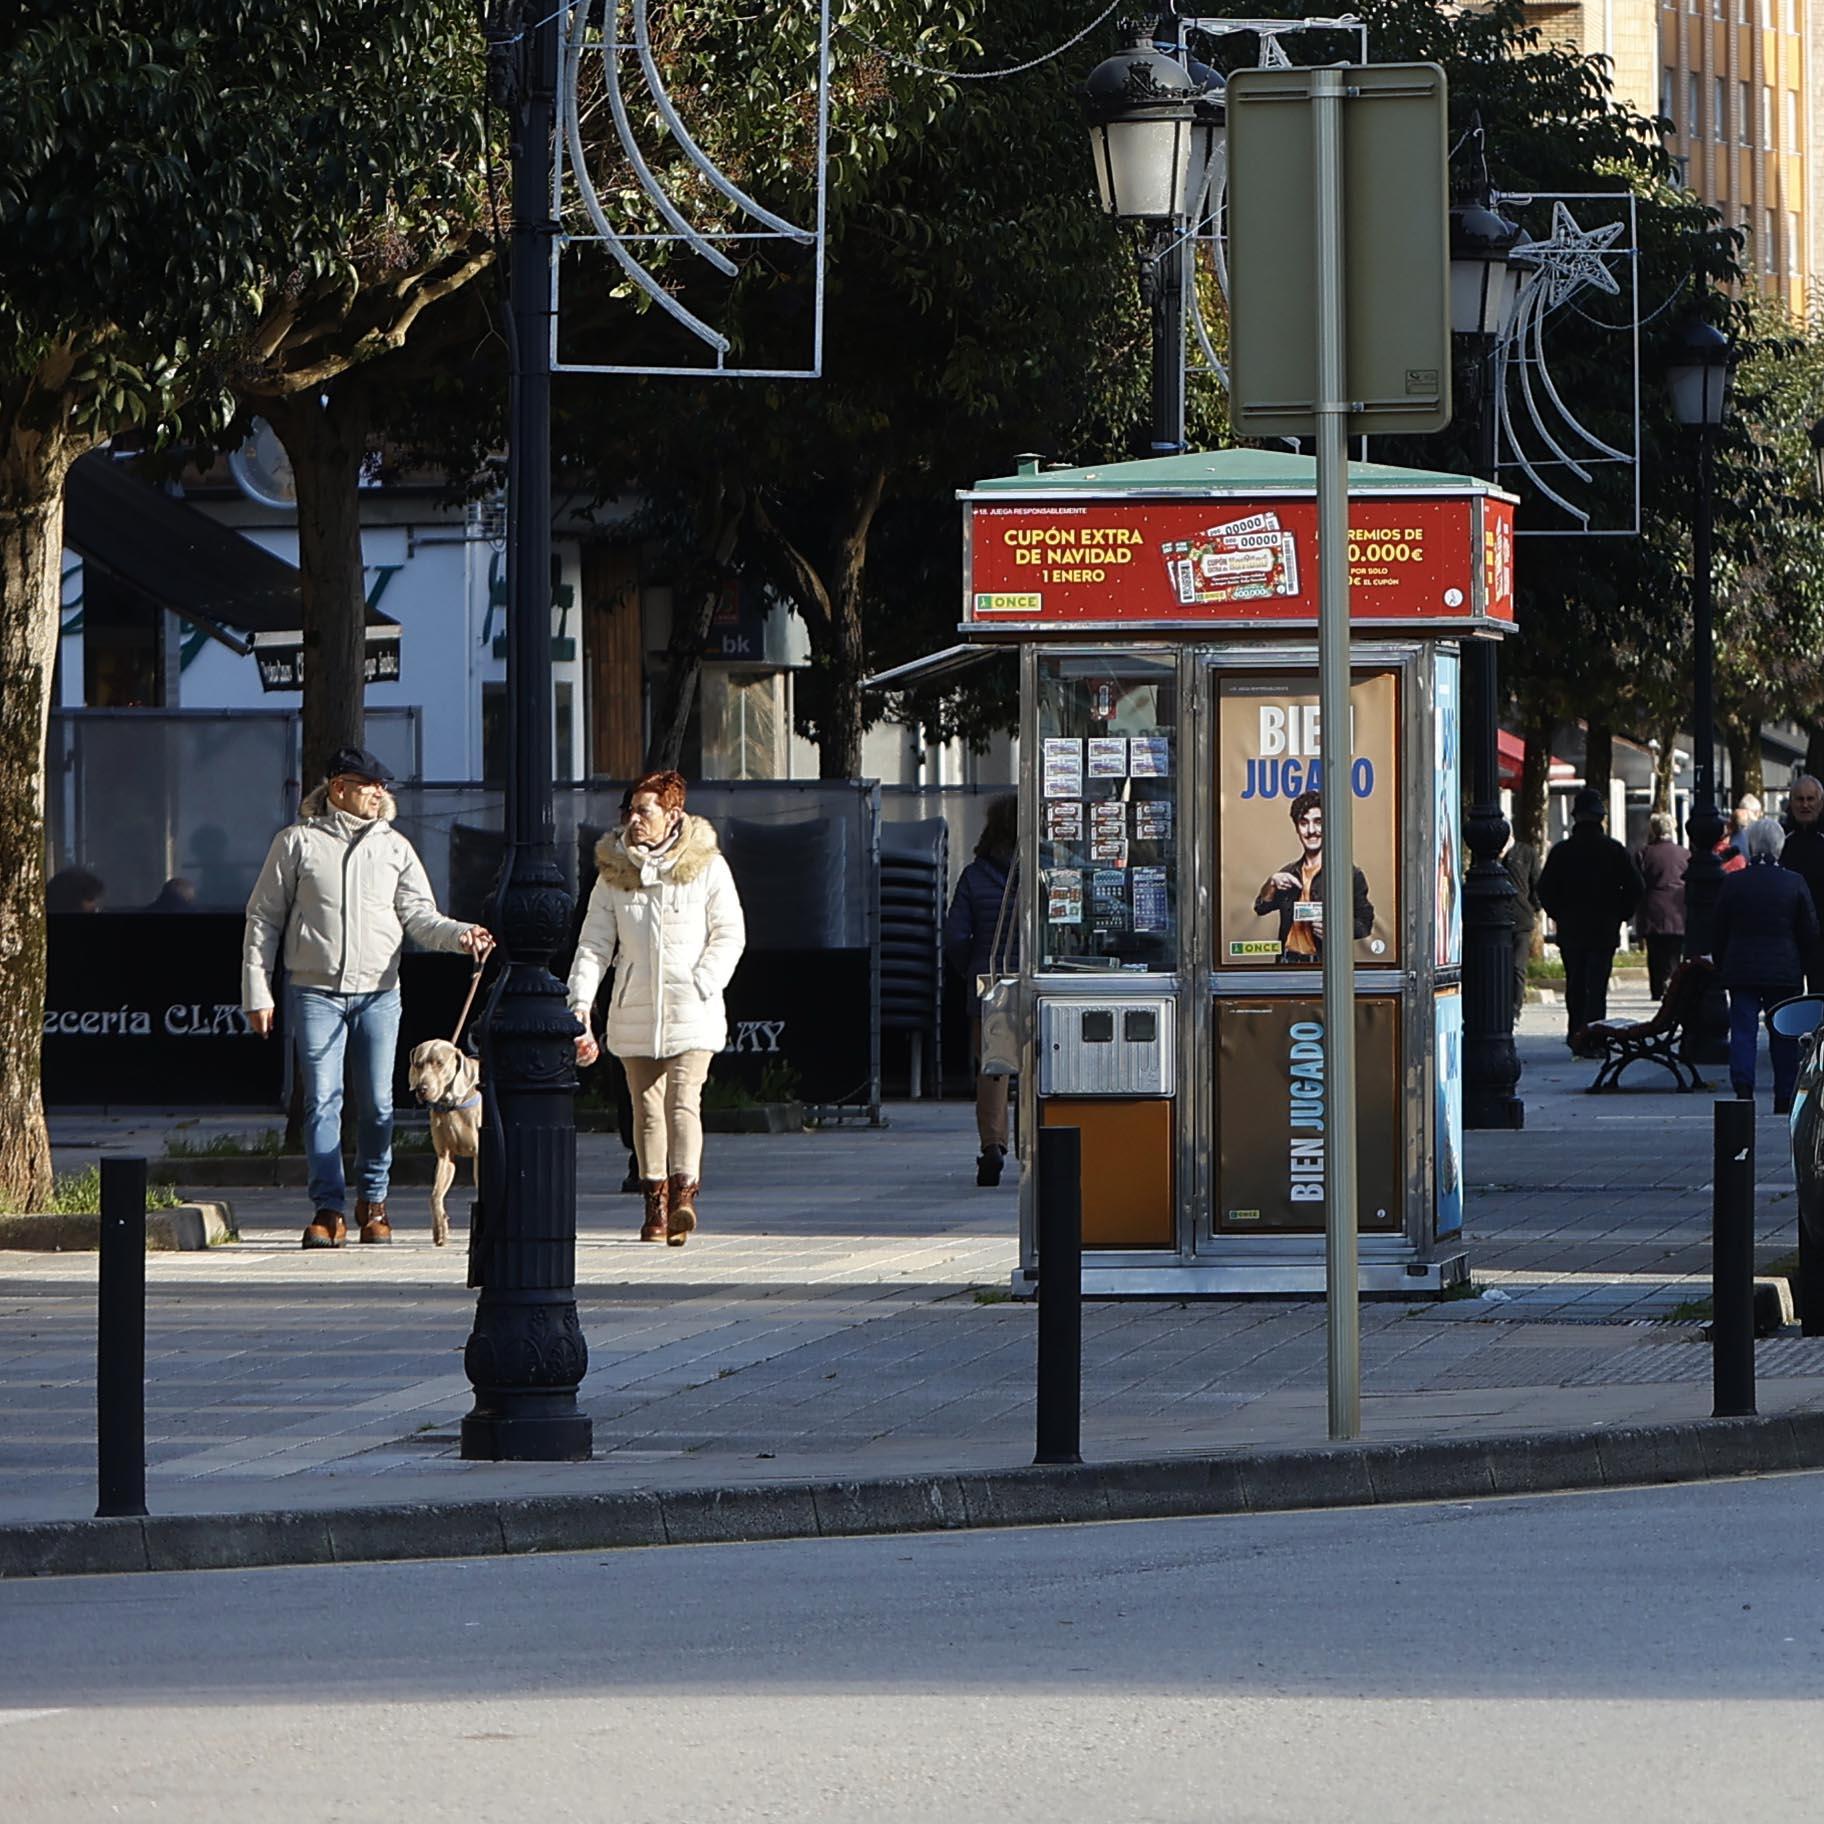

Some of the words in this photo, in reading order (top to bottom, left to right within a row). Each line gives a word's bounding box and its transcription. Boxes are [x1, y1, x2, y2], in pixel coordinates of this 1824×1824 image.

[1004, 526, 1075, 545] CUPÓN
[1081, 529, 1143, 545] EXTRA
[1241, 534, 1278, 547] 00000
[1347, 529, 1391, 540] REMIOS
[1404, 529, 1423, 540] DE
[1016, 548, 1041, 564] DE
[1047, 548, 1132, 564] NAVIDAD
[1043, 570, 1048, 582] 1
[1052, 569, 1105, 582] ENERO
[1373, 577, 1399, 586] CUPÓN
[994, 596, 1038, 607] ONCE
[1259, 704, 1354, 756] BIE
[1240, 758, 1374, 801] JUGAO
[1245, 943, 1279, 953] ONCE
[1290, 1021, 1325, 1131] JUGADO
[1290, 1138, 1325, 1201] BIEN
